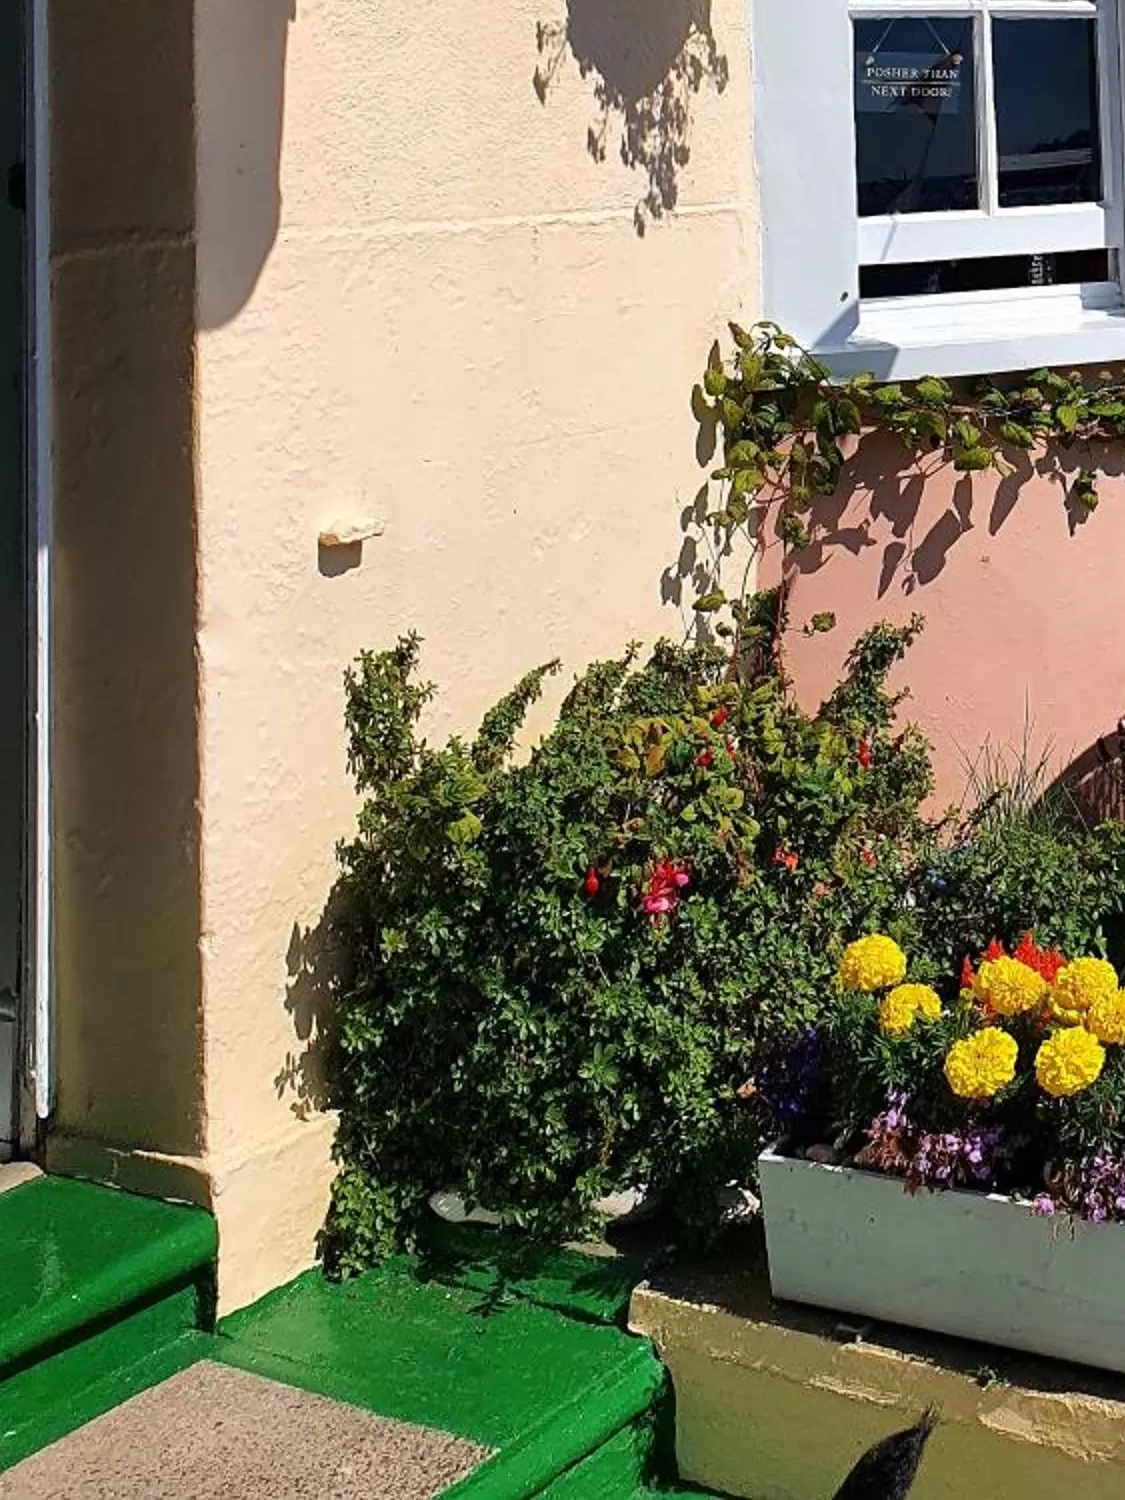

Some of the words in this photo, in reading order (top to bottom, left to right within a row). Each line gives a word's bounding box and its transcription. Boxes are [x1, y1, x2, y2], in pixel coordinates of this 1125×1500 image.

[867, 67, 918, 79] POSHER
[922, 69, 960, 79] THAN
[871, 85, 907, 97] NEXT
